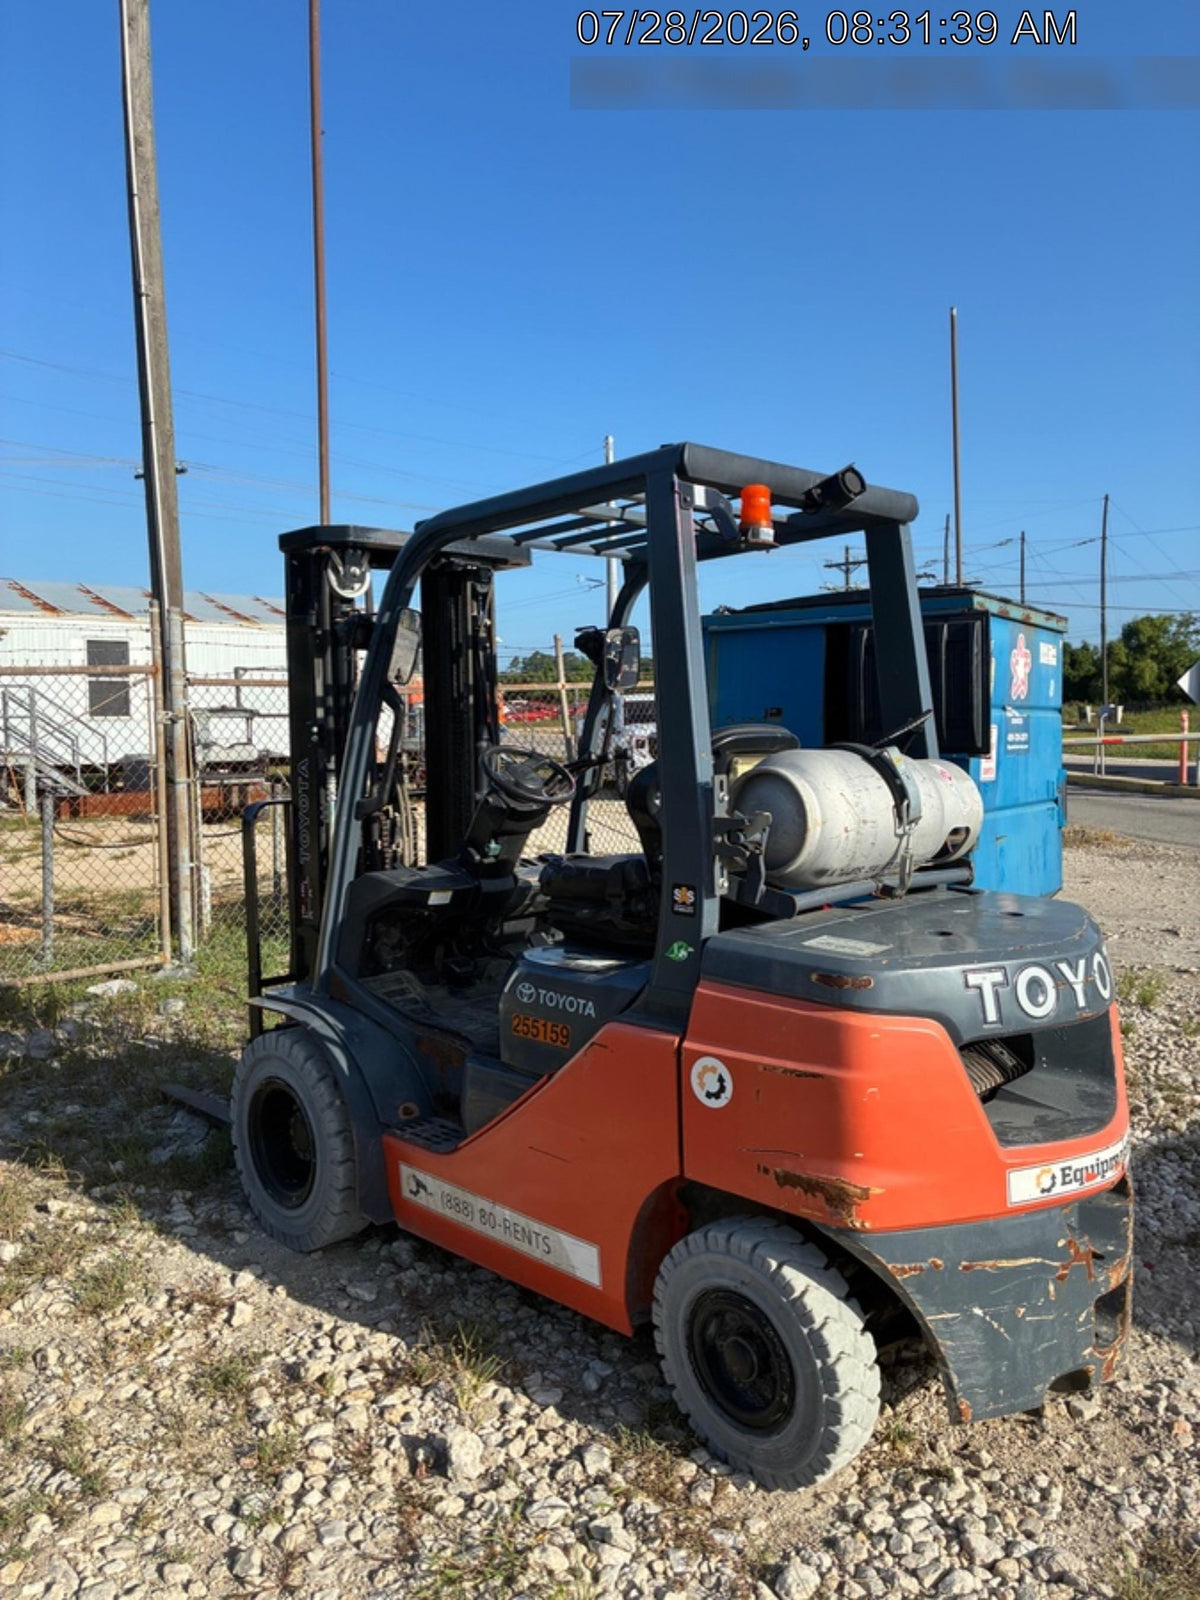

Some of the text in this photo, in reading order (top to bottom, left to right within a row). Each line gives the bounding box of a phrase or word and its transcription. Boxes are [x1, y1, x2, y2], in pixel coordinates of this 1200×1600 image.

[298, 758, 311, 865] TOYOTA
[538, 988, 596, 1018] TOYOTA
[966, 946, 1110, 1023] TOYO
[513, 1014, 570, 1046] 255159
[440, 1190, 551, 1255] (888) 80-RENTS
